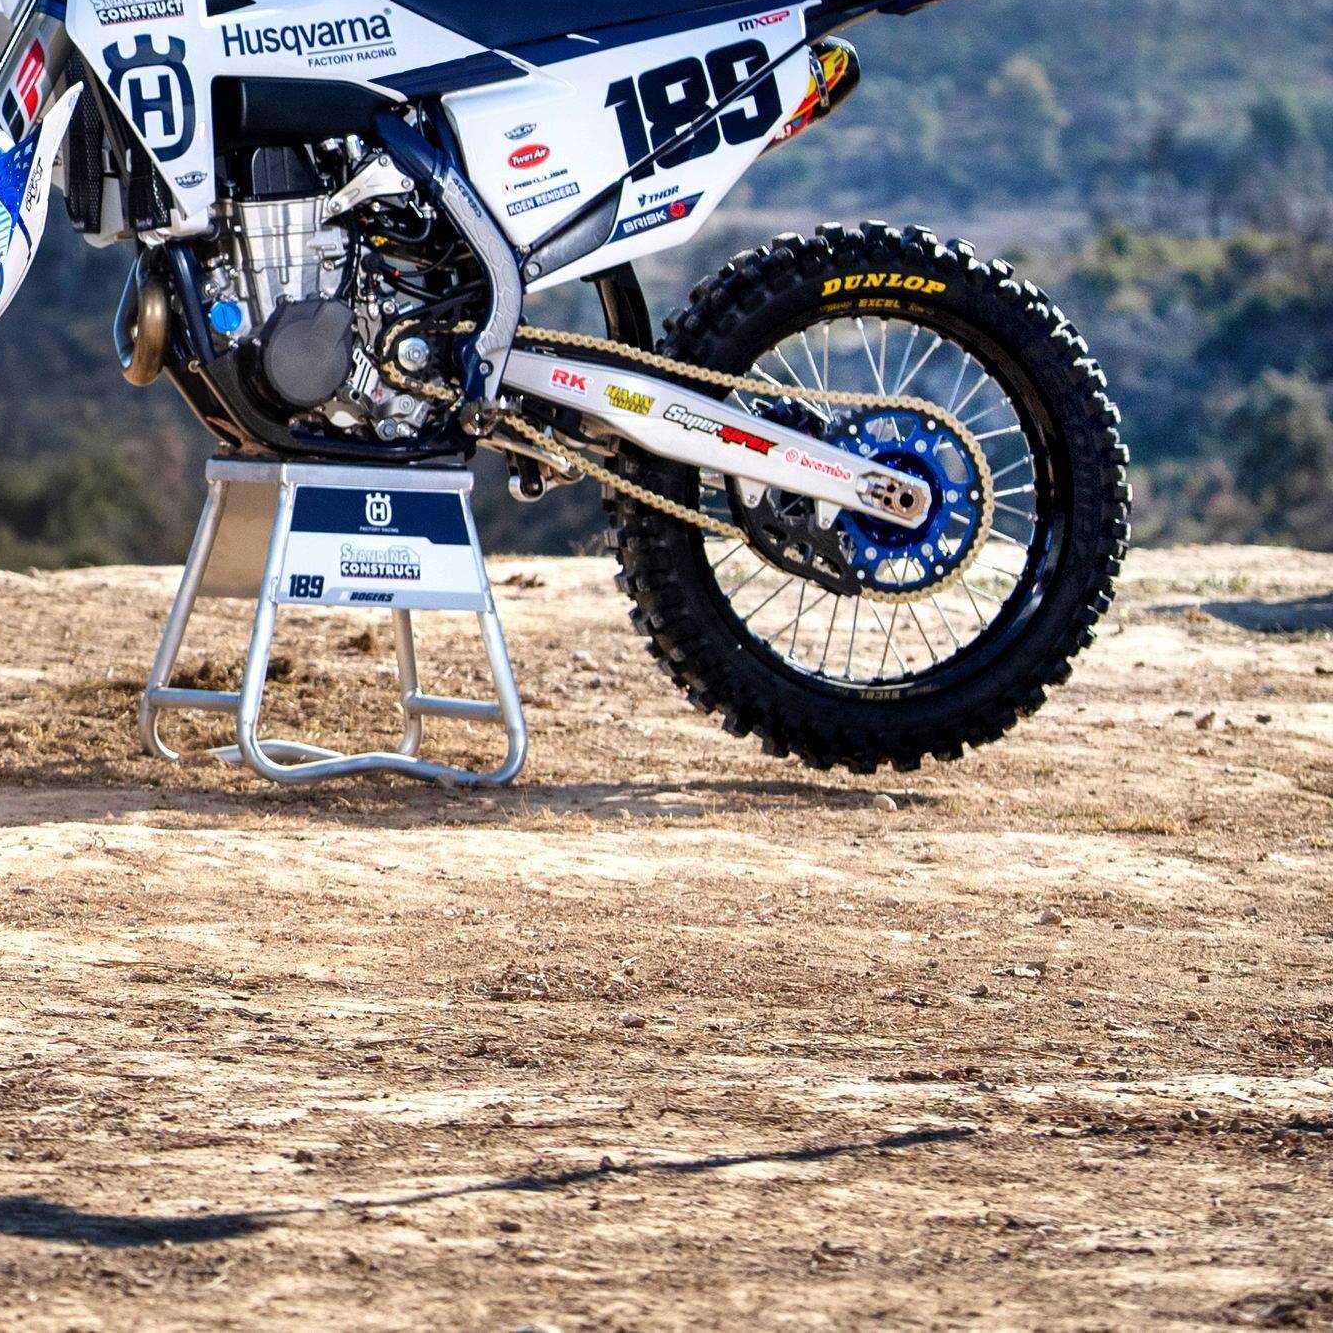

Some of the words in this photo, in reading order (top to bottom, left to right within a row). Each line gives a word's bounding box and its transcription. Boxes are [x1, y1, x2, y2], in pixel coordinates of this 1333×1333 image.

[98, 0, 183, 22] CONSTRUCT
[738, 10, 790, 32] MXGP
[222, 13, 391, 57] Husqvarna
[308, 52, 354, 68] FACTORY
[357, 47, 396, 63] RACING
[605, 39, 782, 182] 189
[512, 152, 533, 166] Twin
[534, 148, 550, 159] Air
[509, 197, 535, 215] KOEN
[536, 185, 579, 209] RENDERS
[647, 186, 680, 204] THOR
[623, 212, 667, 233] BRISK
[822, 273, 947, 296] DUNLOP
[551, 369, 588, 391] RK
[801, 454, 852, 480] brembo
[341, 544, 408, 563] STANDING
[341, 562, 420, 578] CONSTRUCT
[289, 574, 325, 598] 189
[349, 592, 394, 603] BOGERS
